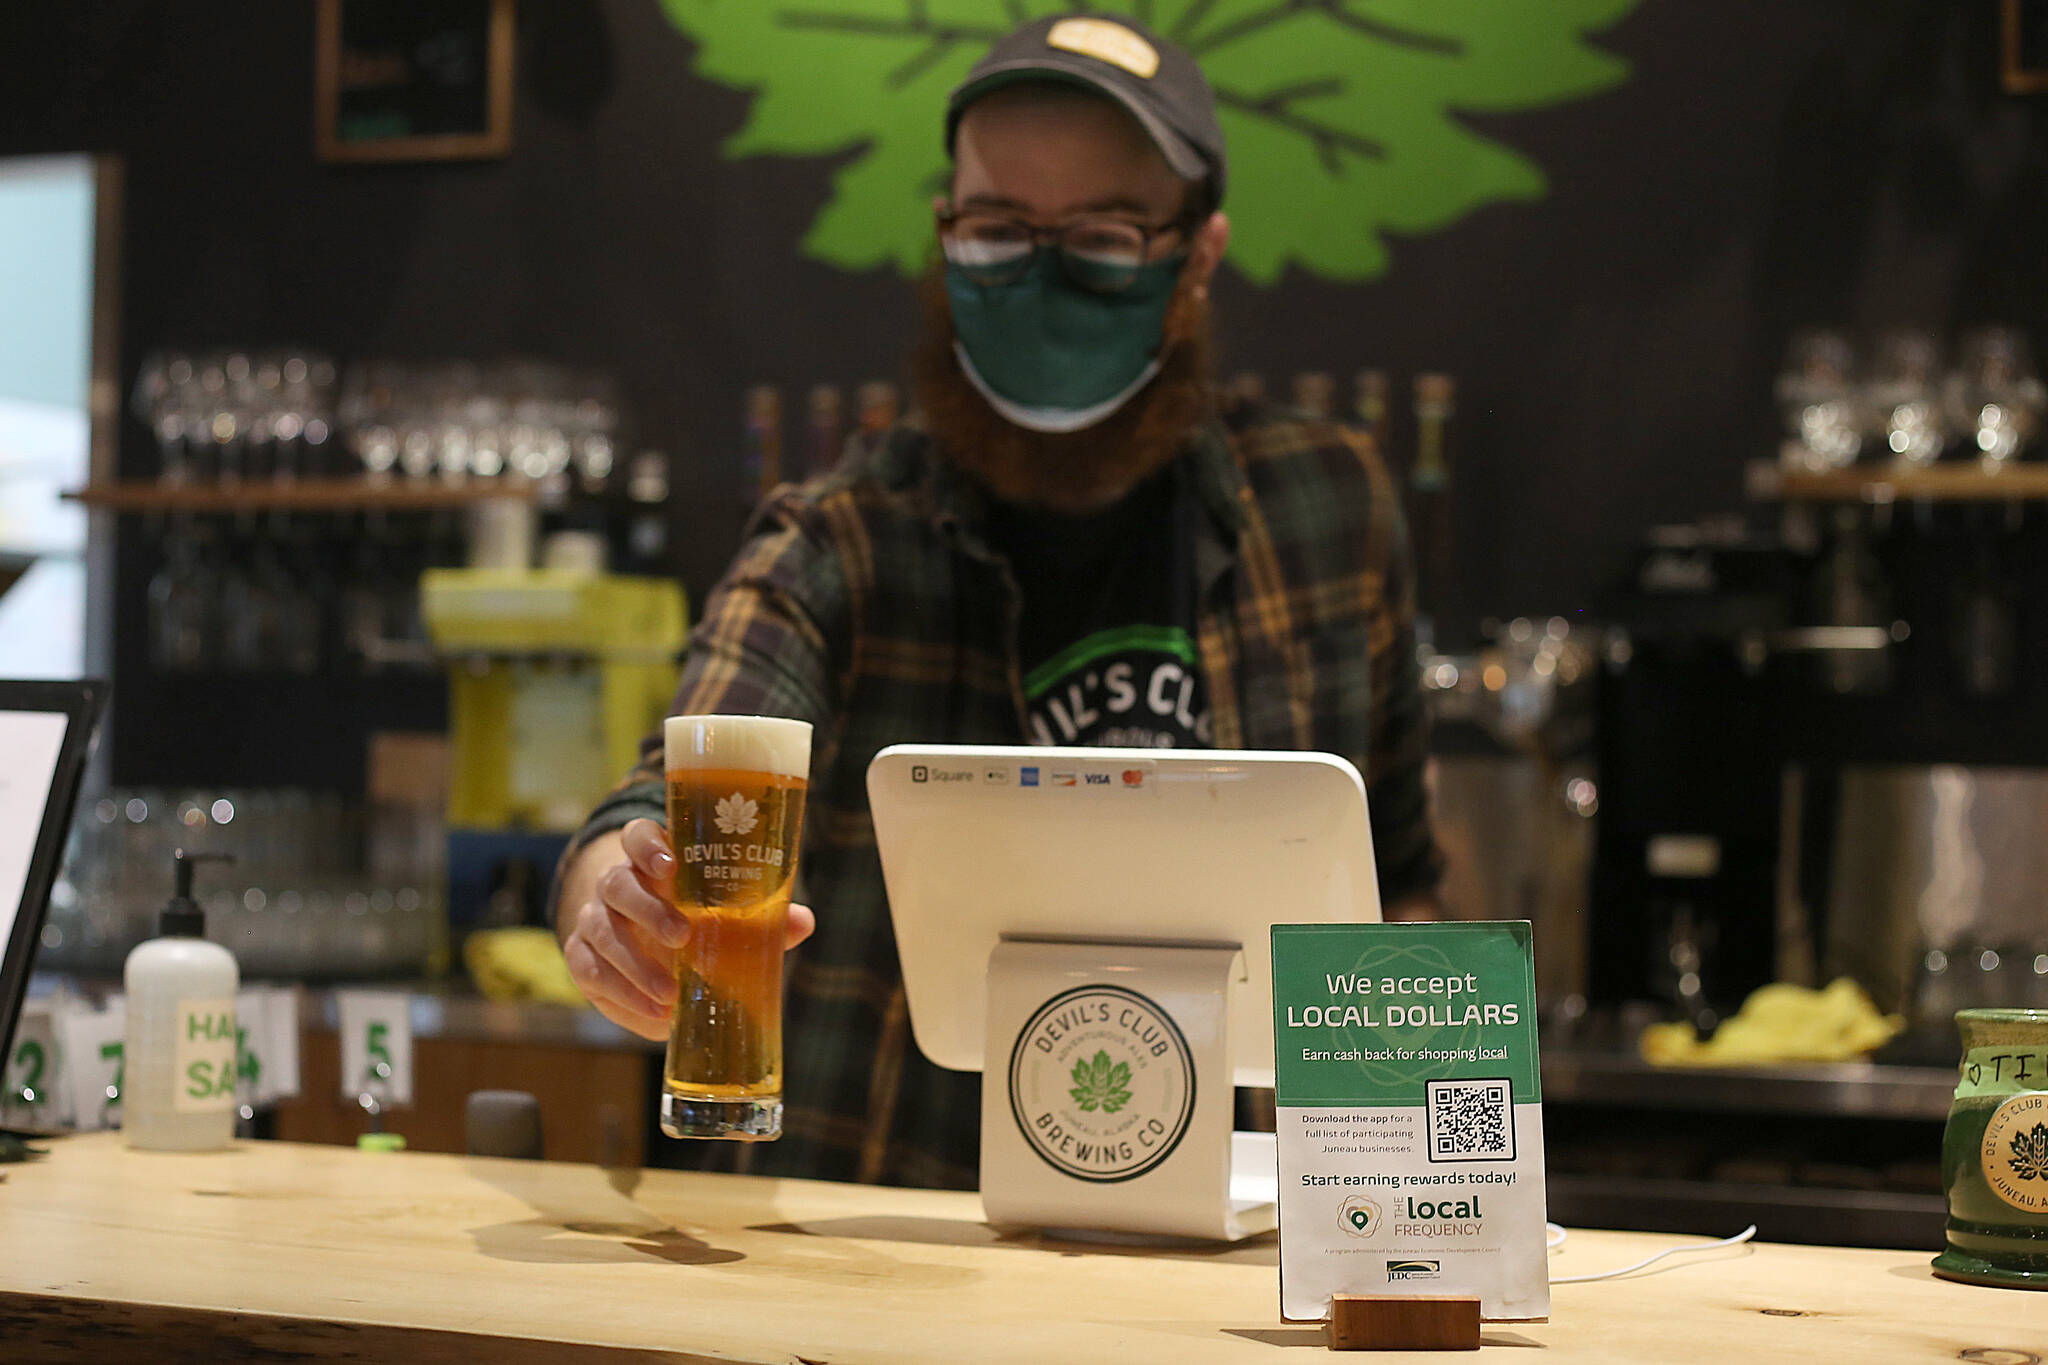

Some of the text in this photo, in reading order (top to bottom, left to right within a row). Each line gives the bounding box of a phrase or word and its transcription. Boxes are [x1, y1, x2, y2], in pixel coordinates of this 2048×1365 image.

[1085, 774, 1111, 785] VISA
[684, 843, 784, 866] DEVIL'S CLUB
[704, 865, 762, 880] BREWING
[1325, 972, 1478, 999] We accept
[1287, 1003, 1519, 1028] LOCAL DOLLARS
[1036, 1003, 1169, 1057] DEVIL'S CLUB
[366, 1022, 391, 1080] 5
[1302, 1045, 1508, 1063] Earn cash back for shopping local
[2011, 1099, 2042, 1116] CLUB
[1302, 1114, 1413, 1125] Download the app for a
[1036, 1113, 1165, 1164] BREWING CO
[1305, 1129, 1414, 1139] full list of participating
[1321, 1144, 1414, 1153] Juneau businesses.
[1301, 1171, 1517, 1189] Start earning rewards today!
[1394, 1196, 1404, 1218] THE
[1407, 1195, 1482, 1219] local
[1394, 1223, 1483, 1237] FREQUENCY
[1387, 1272, 1412, 1283] JEDC
